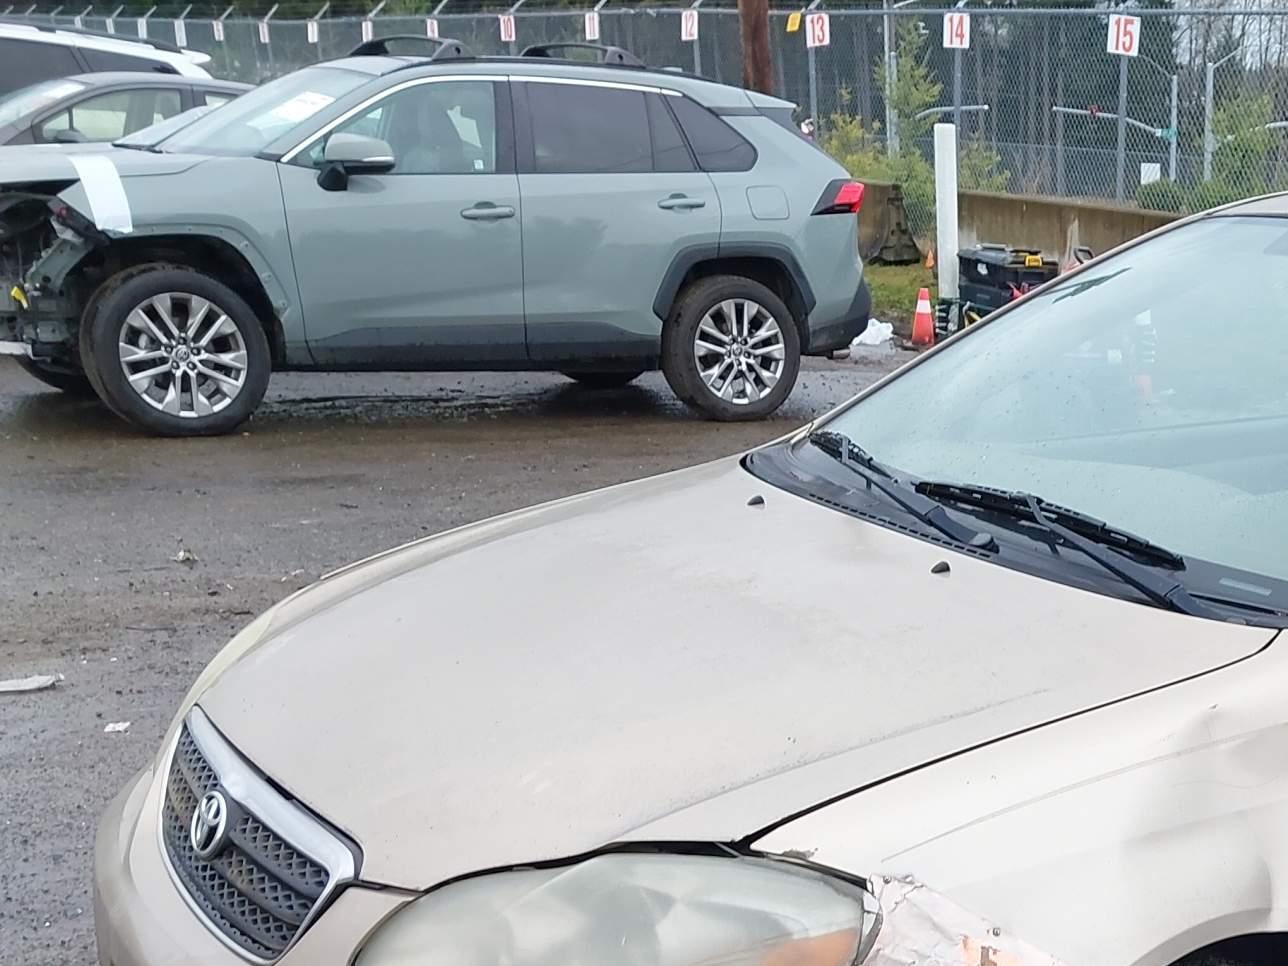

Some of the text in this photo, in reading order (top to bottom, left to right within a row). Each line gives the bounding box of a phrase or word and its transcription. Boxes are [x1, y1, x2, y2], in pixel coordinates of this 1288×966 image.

[502, 16, 513, 40] 10
[588, 14, 597, 38] 11
[684, 11, 695, 38] 12
[810, 15, 825, 44] 13
[949, 14, 965, 46] 14
[1114, 16, 1135, 53] 15
